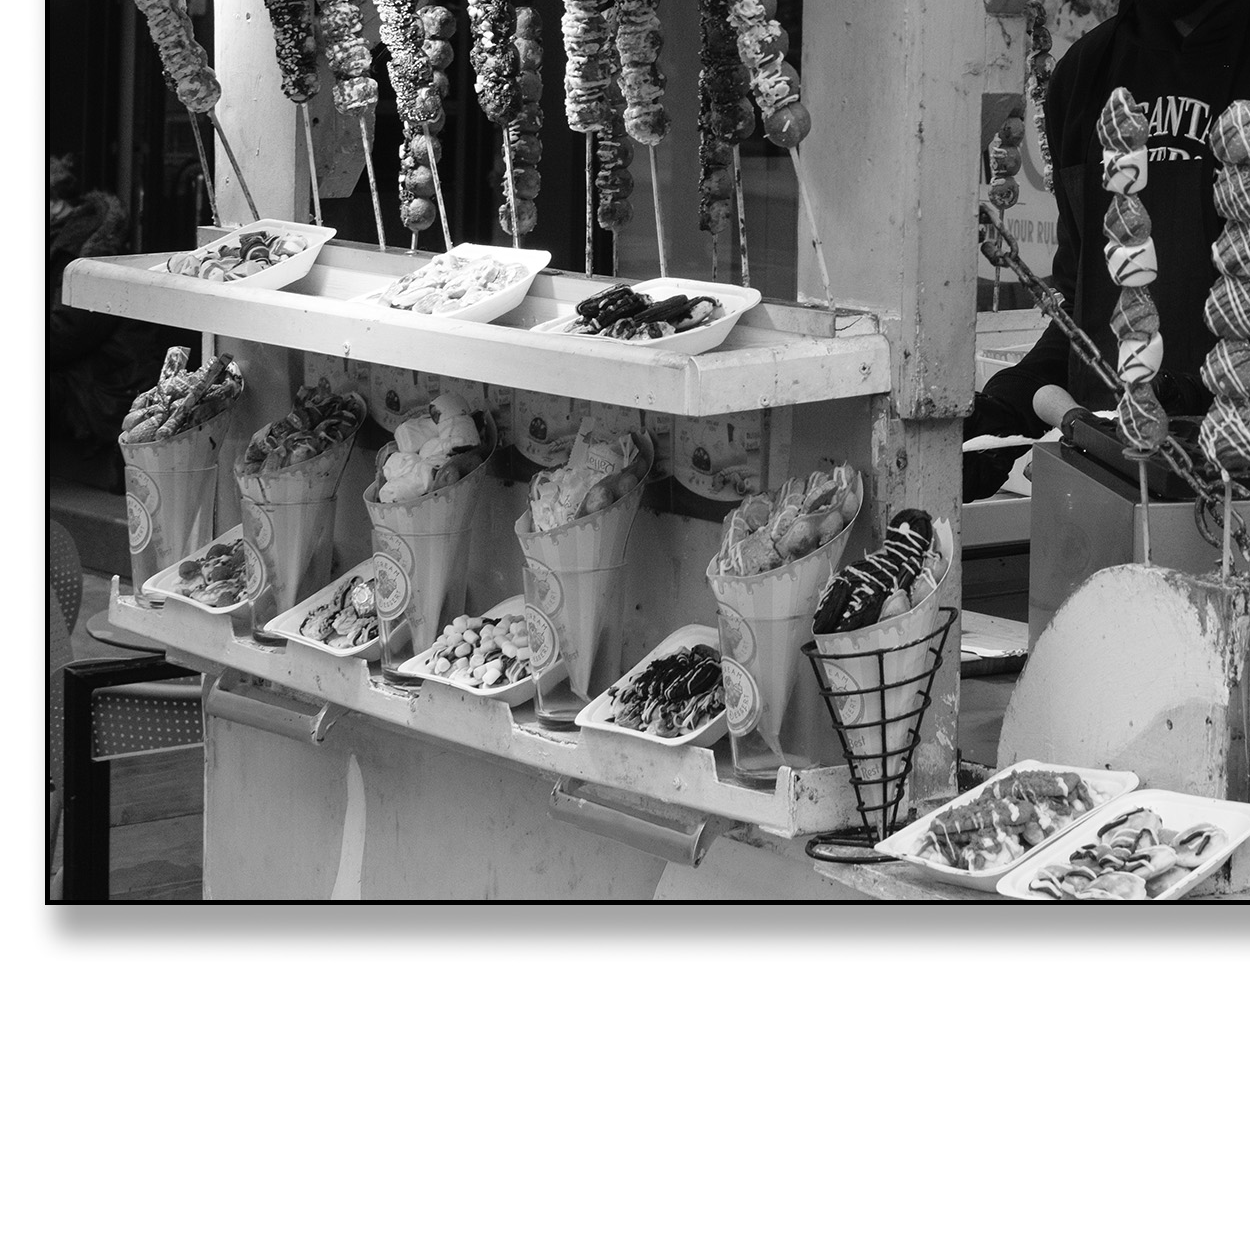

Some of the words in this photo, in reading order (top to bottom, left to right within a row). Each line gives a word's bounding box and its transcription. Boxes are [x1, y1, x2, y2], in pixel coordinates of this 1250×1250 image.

[1007, 218, 1034, 243] YOUR
[1037, 221, 1059, 245] RUL
[861, 763, 880, 780] Rest
